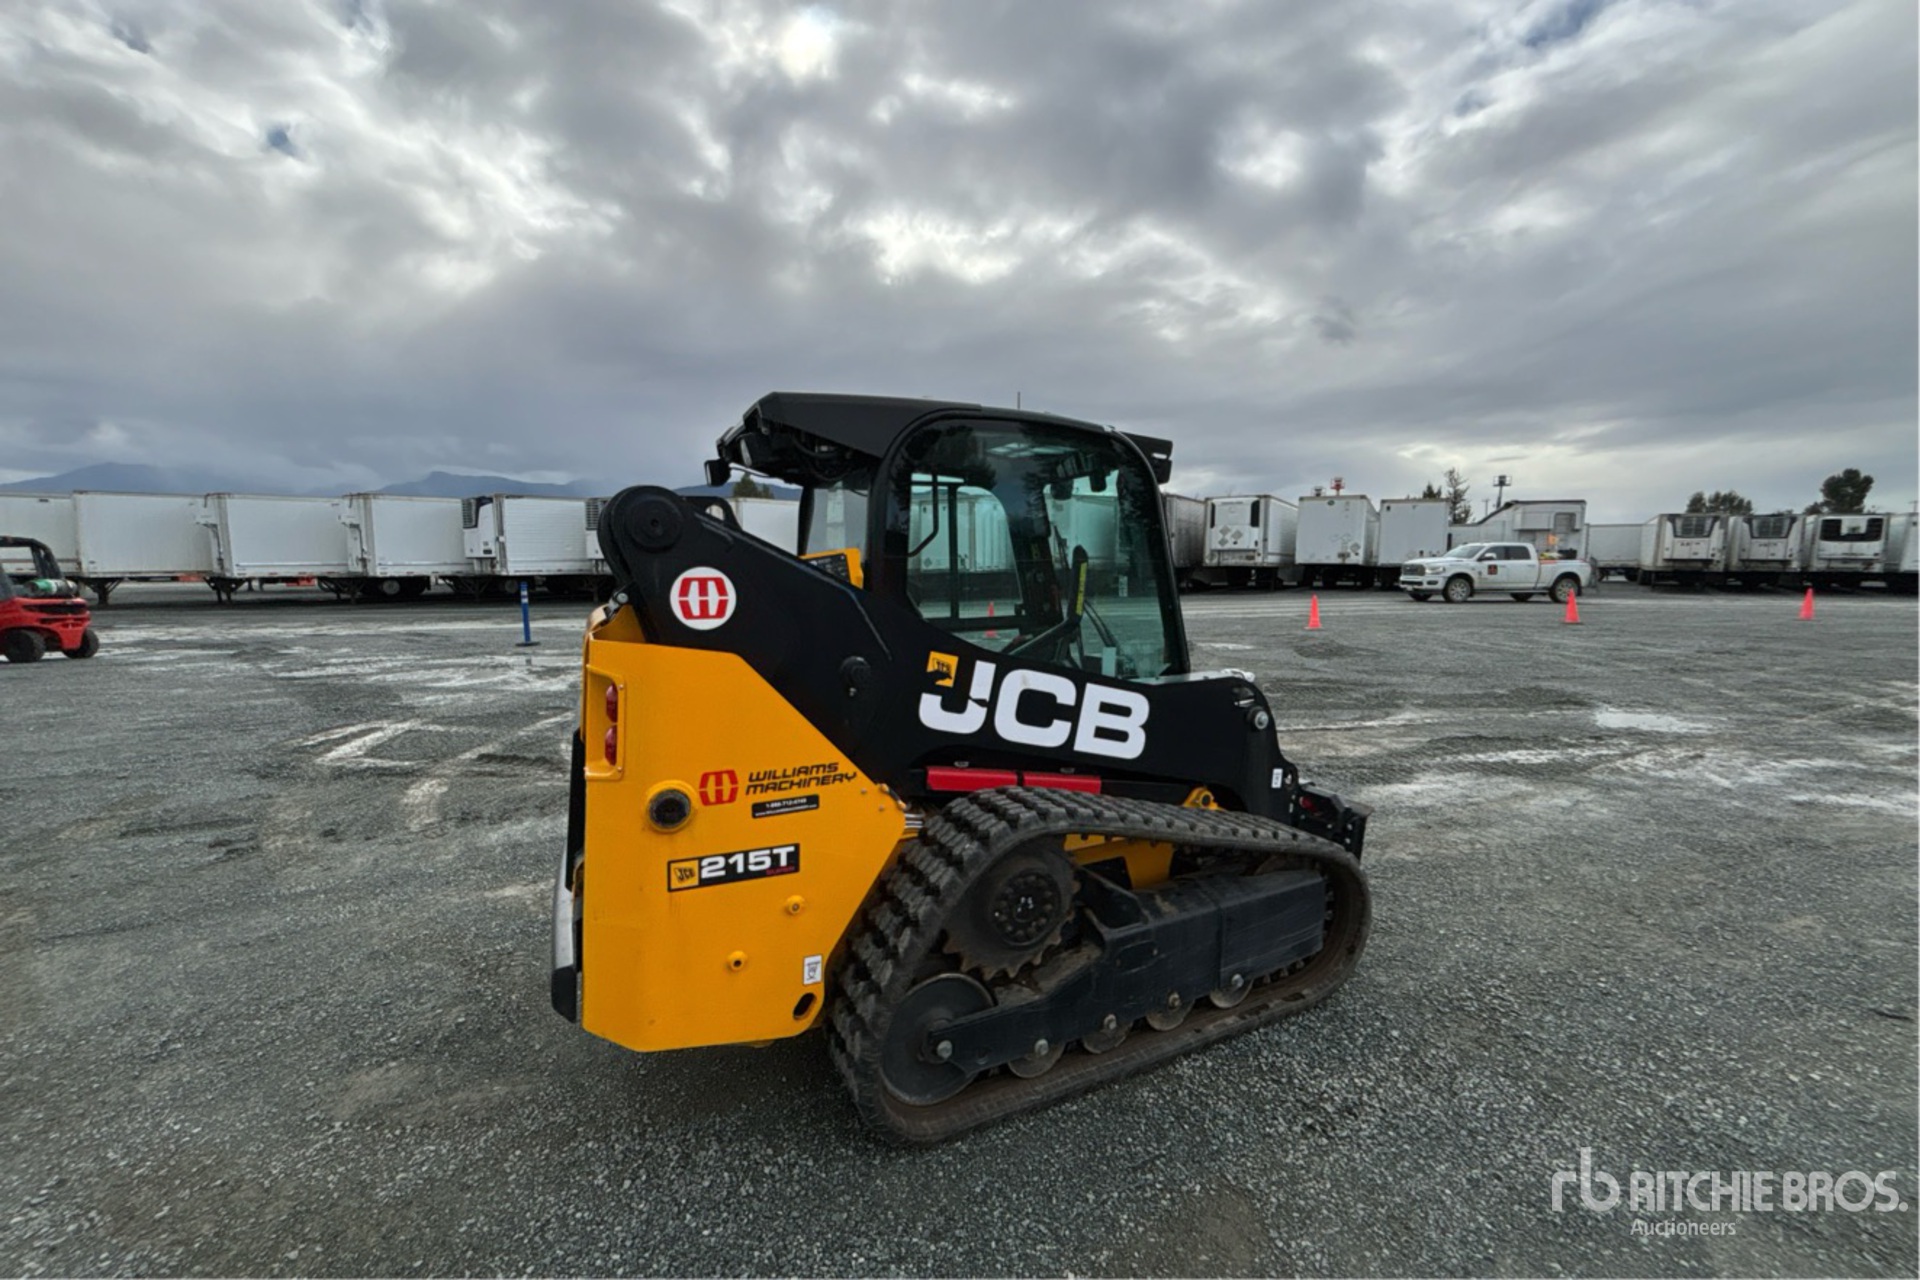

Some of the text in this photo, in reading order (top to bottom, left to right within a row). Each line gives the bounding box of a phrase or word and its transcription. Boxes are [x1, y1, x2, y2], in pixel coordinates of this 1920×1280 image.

[918, 660, 1150, 760] JCB
[745, 771, 857, 795] MACHINERY
[748, 762, 839, 782] WILLIAMS
[700, 845, 795, 879] 215T
